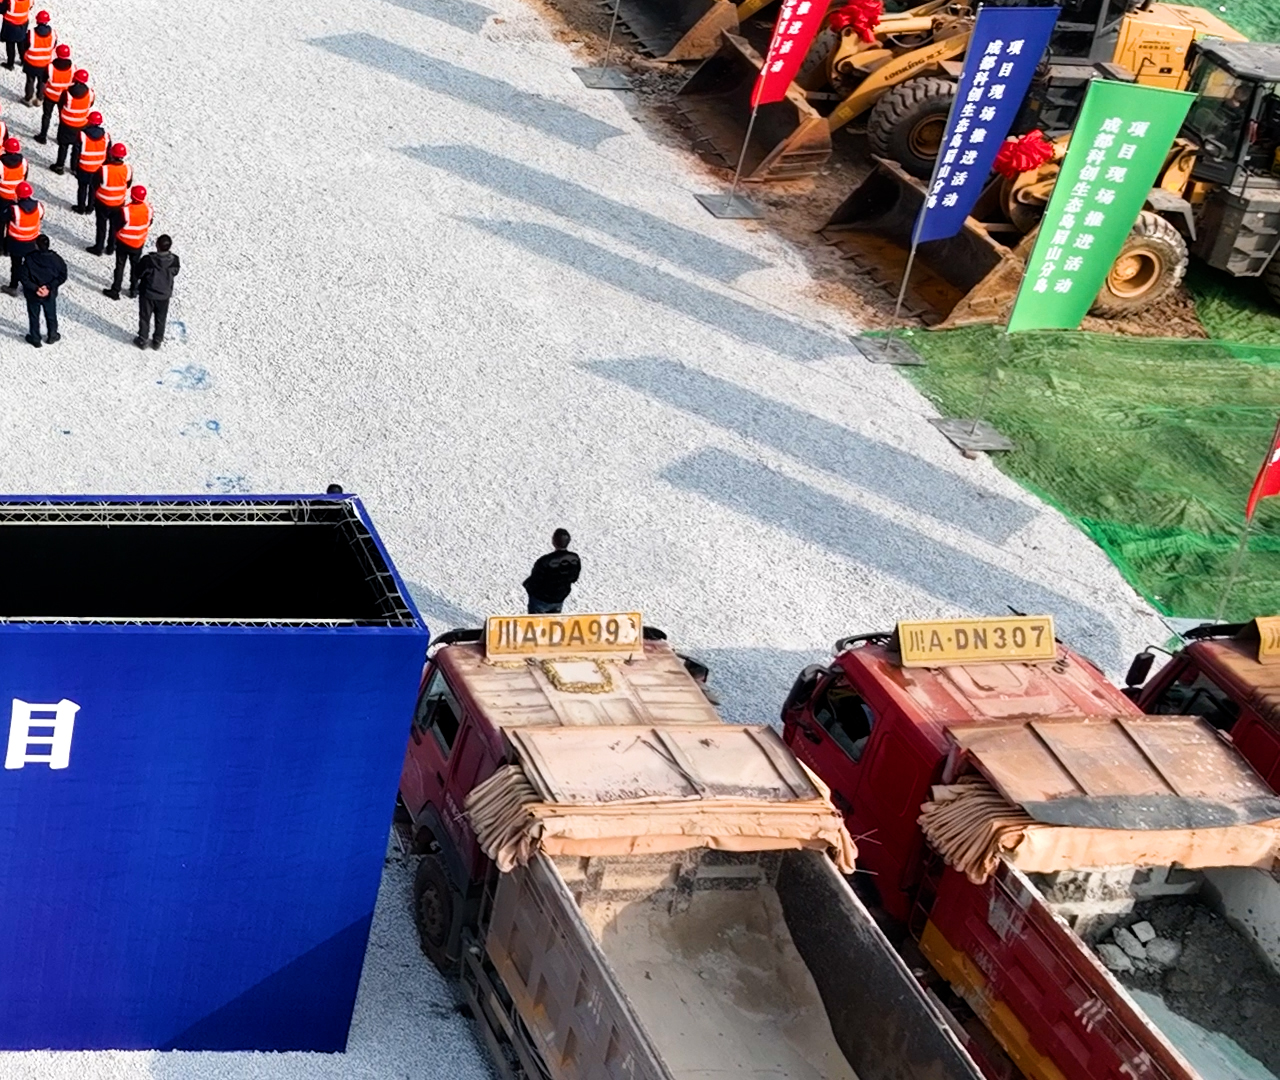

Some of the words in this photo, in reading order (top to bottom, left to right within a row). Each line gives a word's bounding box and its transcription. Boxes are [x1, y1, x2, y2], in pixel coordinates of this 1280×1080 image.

[927, 39, 1004, 210] 成都科创生态岛眉山分岛
[942, 39, 1025, 208] 项目现场推进活动
[1032, 116, 1124, 294] 成都科创生态岛眉山分岛
[1053, 120, 1151, 294] 项目现场推进活动
[496, 618, 637, 651] 川A·DA99
[909, 624, 1045, 653] 川A·DN307
